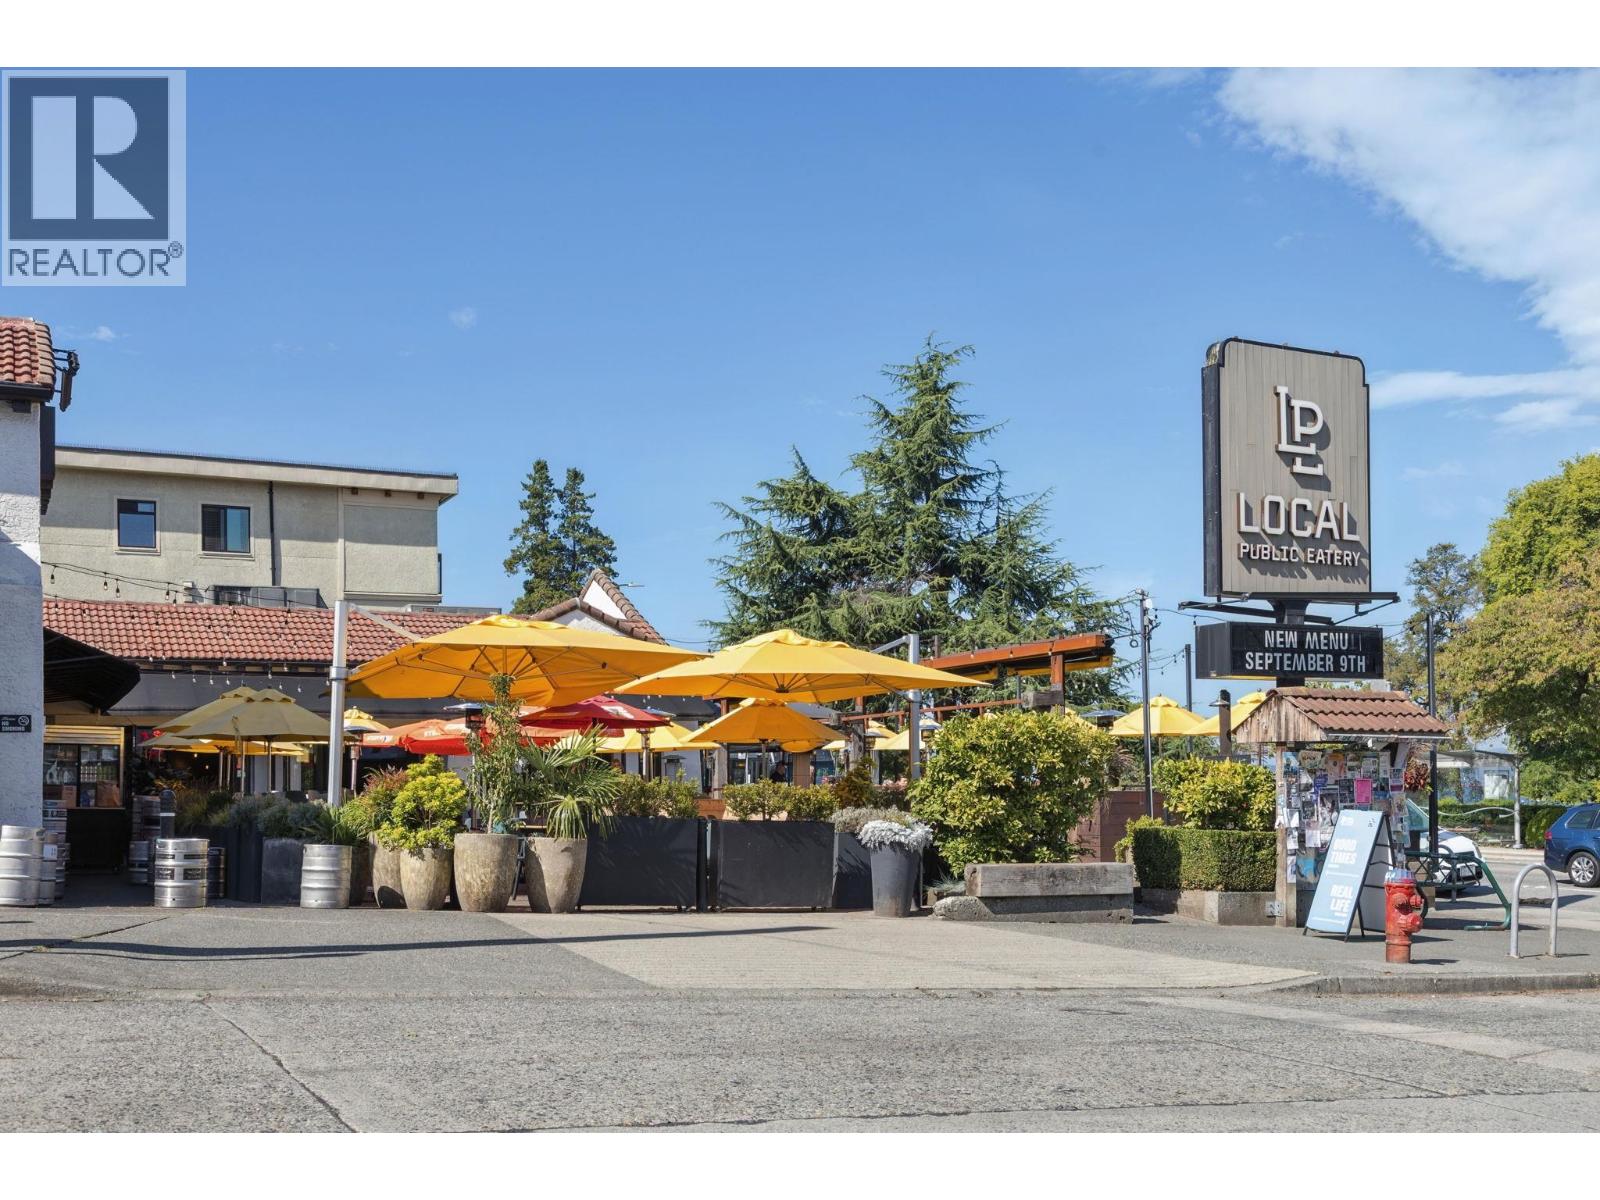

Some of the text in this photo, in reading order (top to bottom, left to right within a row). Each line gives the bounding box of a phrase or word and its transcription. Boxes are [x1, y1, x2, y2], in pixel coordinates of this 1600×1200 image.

[1238, 492, 1360, 541] LOCAL
[1239, 543, 1361, 567] PUBLIC EATERY
[1264, 630, 1349, 650] NEW MENU
[1245, 652, 1366, 673] SEPTEMBER 9TH
[1330, 884, 1353, 899] REAL
[1330, 898, 1352, 912] LIFE
